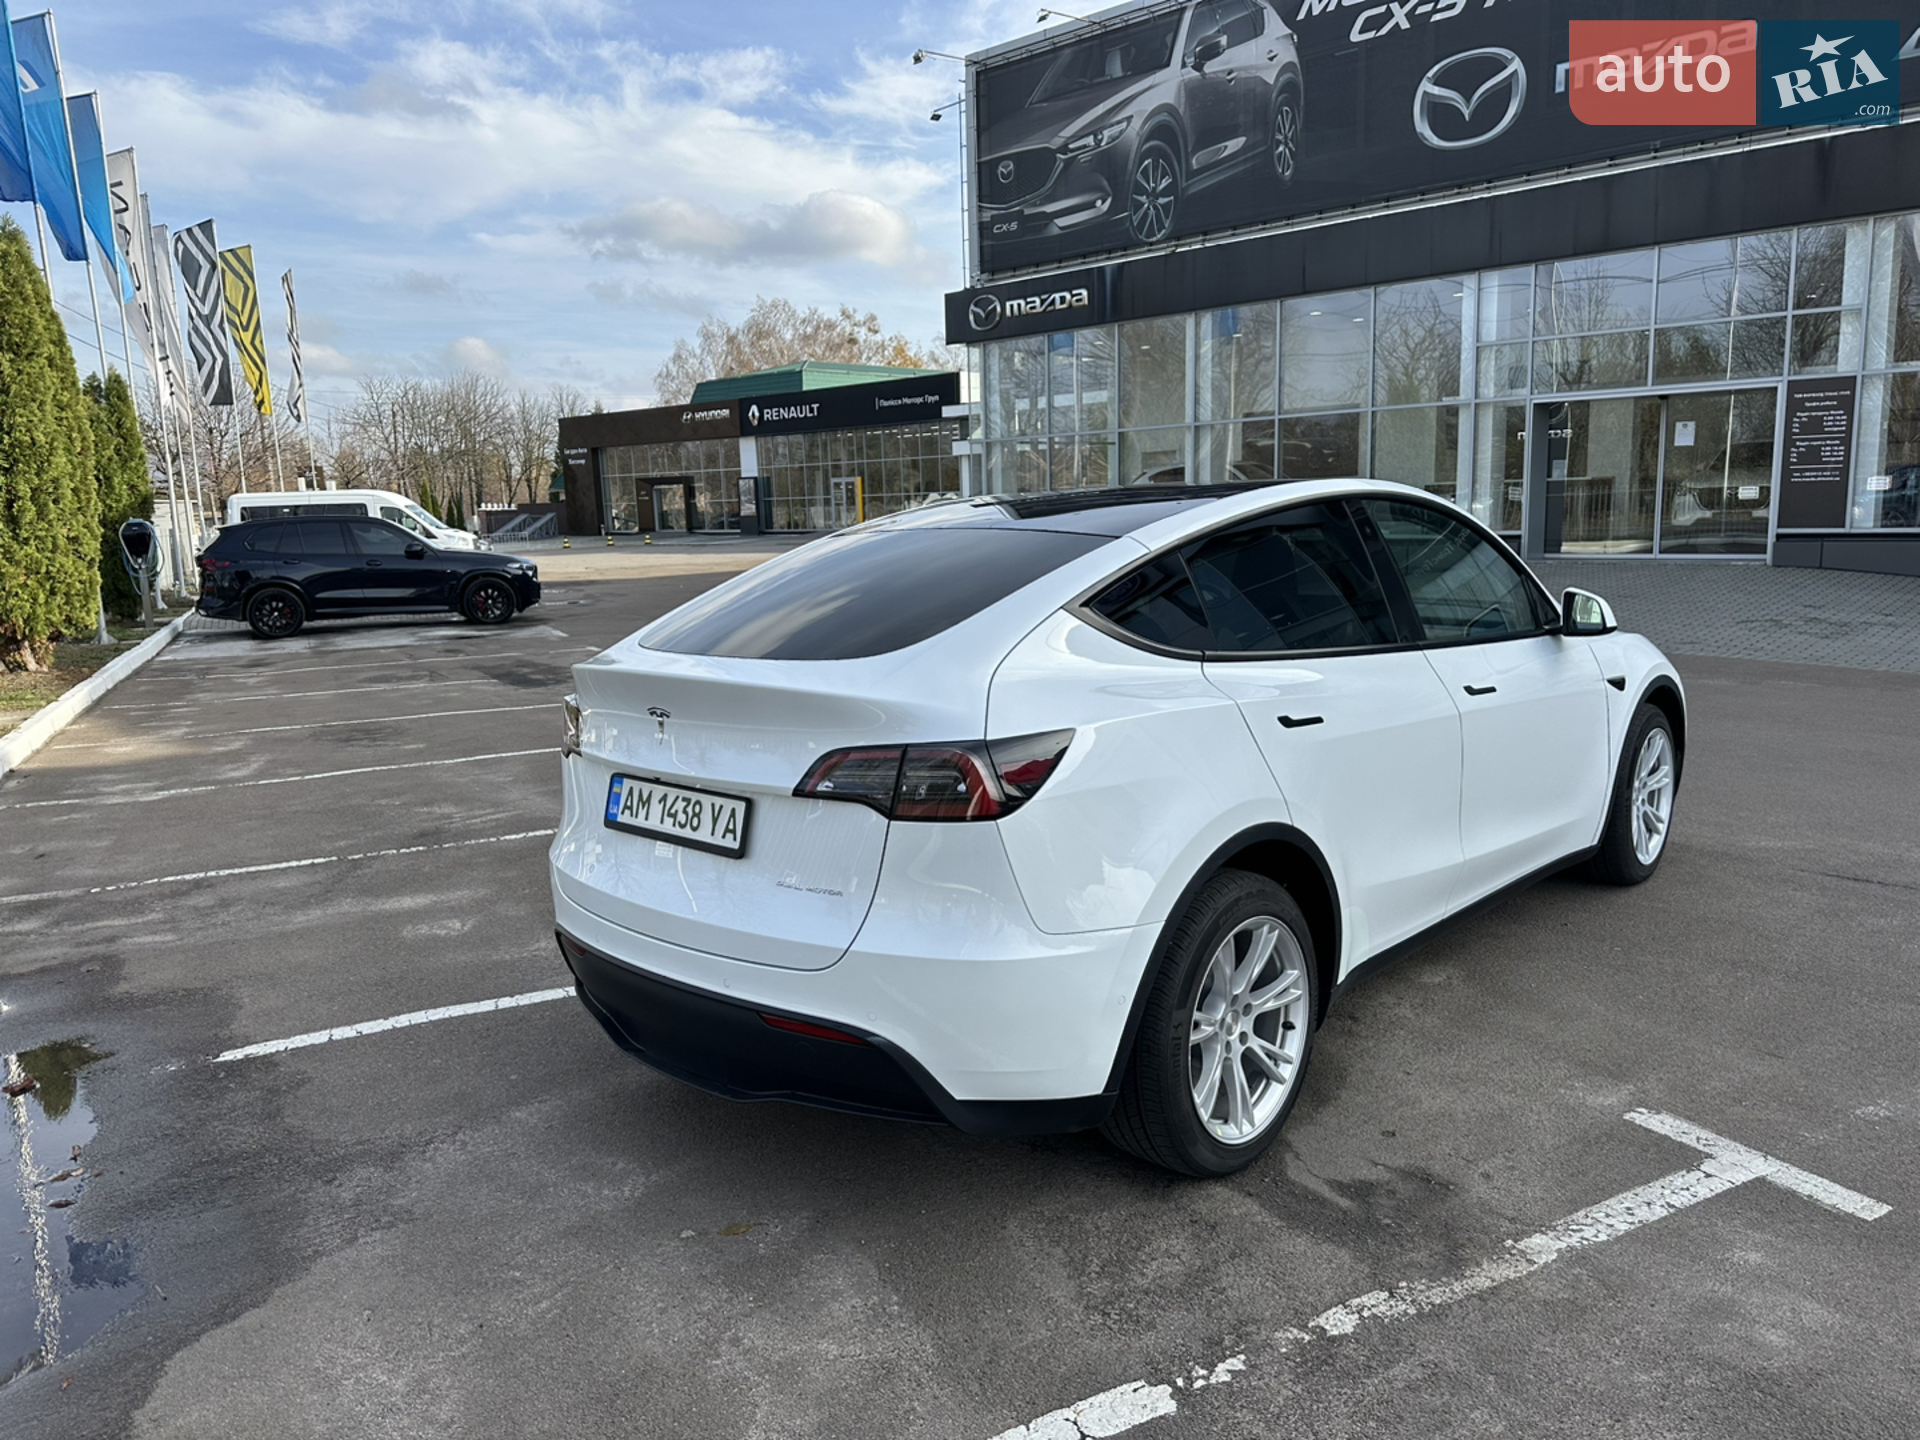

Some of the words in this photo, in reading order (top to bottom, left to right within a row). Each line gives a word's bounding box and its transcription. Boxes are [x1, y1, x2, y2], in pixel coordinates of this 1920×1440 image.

[993, 221, 1018, 233] CX-5
[694, 408, 730, 422] HYUNDAI
[763, 403, 820, 421] RENAULT
[620, 786, 653, 821] AM
[657, 792, 702, 833] 1438
[710, 802, 738, 842] YA
[805, 887, 844, 897] MOTOR
